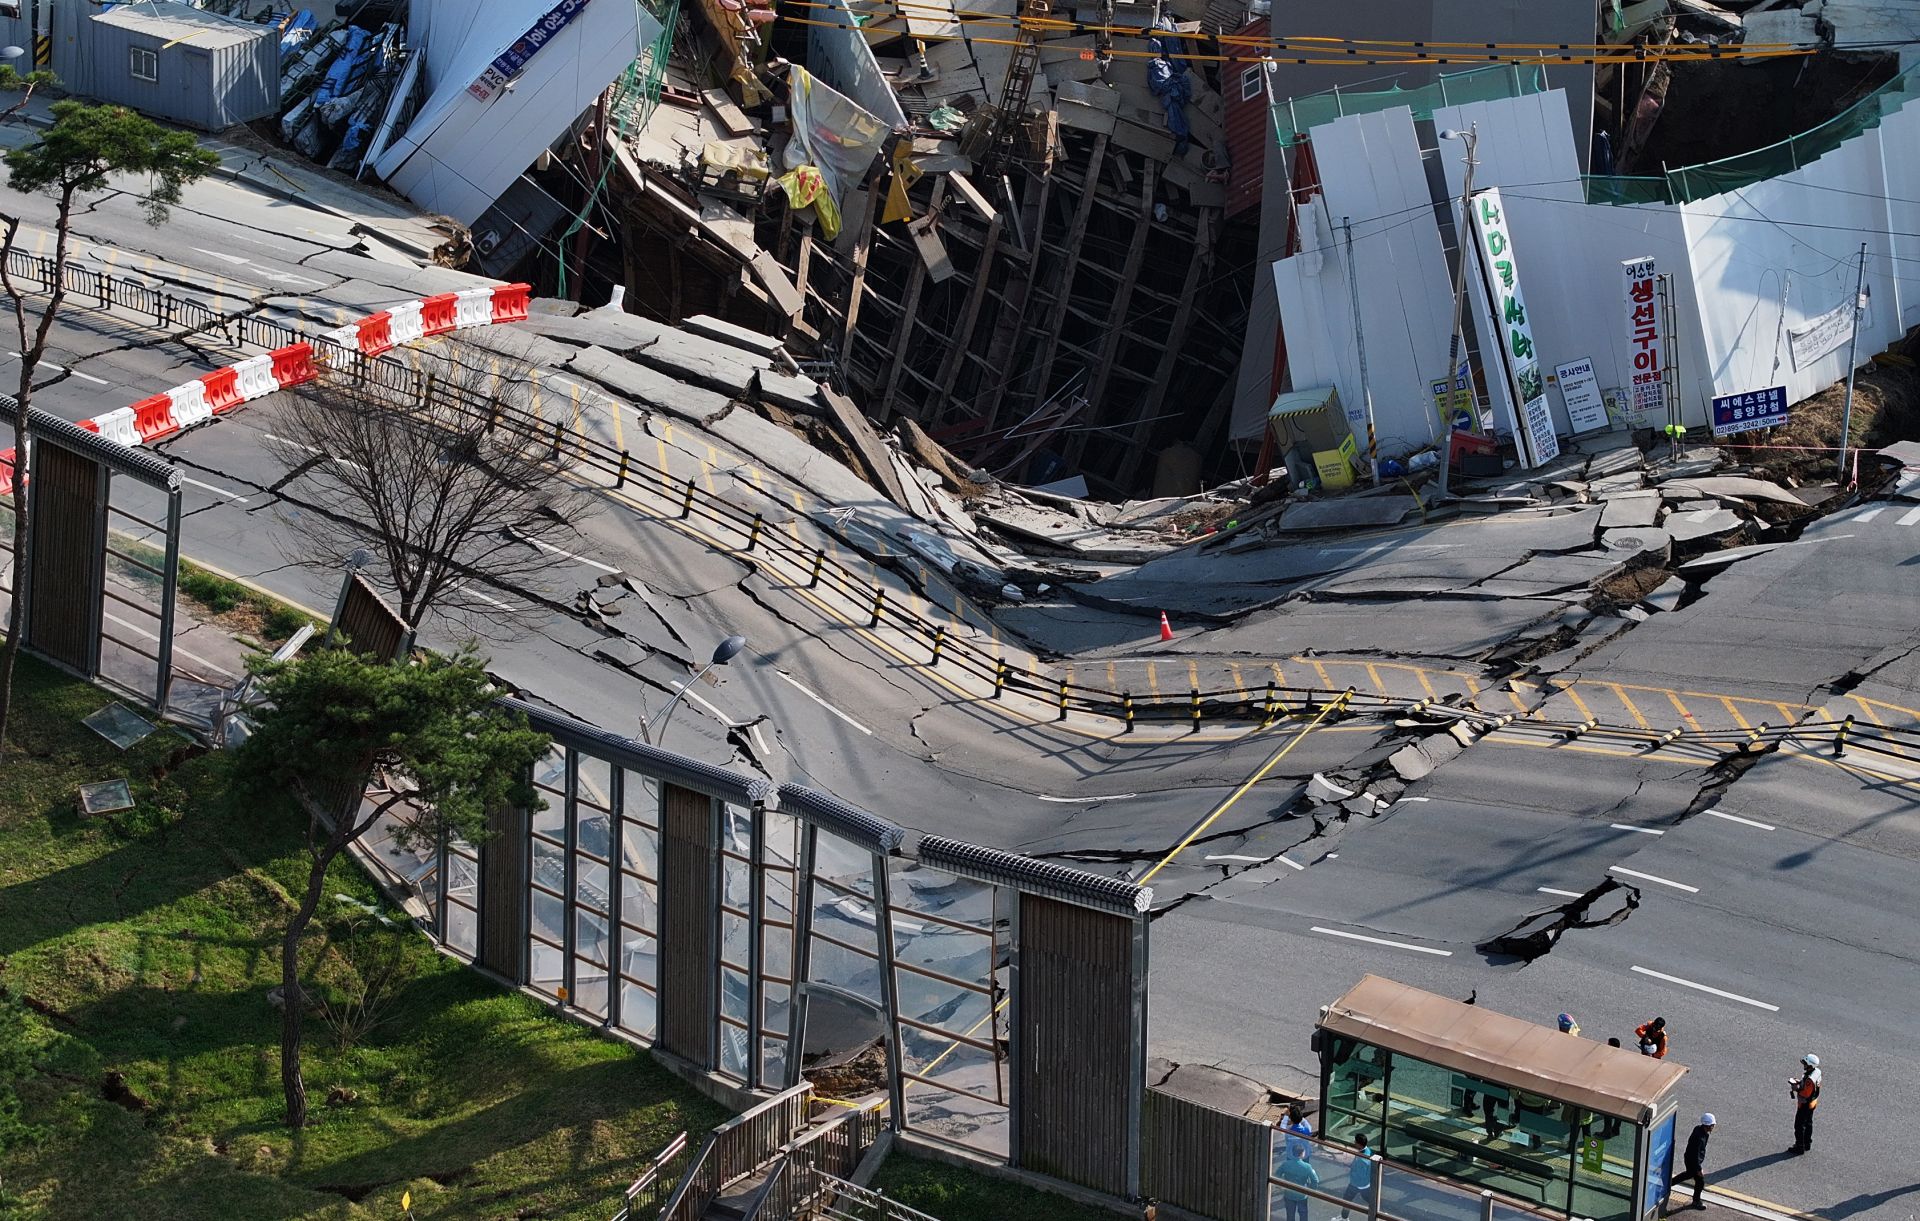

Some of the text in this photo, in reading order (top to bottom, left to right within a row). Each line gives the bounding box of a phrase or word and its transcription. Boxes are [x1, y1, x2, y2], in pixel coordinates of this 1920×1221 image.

[484, 67, 504, 85] PVC
[1626, 261, 1655, 279] 어소반
[1629, 278, 1658, 371] 생선구이
[1560, 364, 1591, 379] 공사안내
[1632, 371, 1662, 385] 전문점
[1733, 401, 1779, 419] 동양강철
[1716, 417, 1777, 434] 02)895-3242 50m
